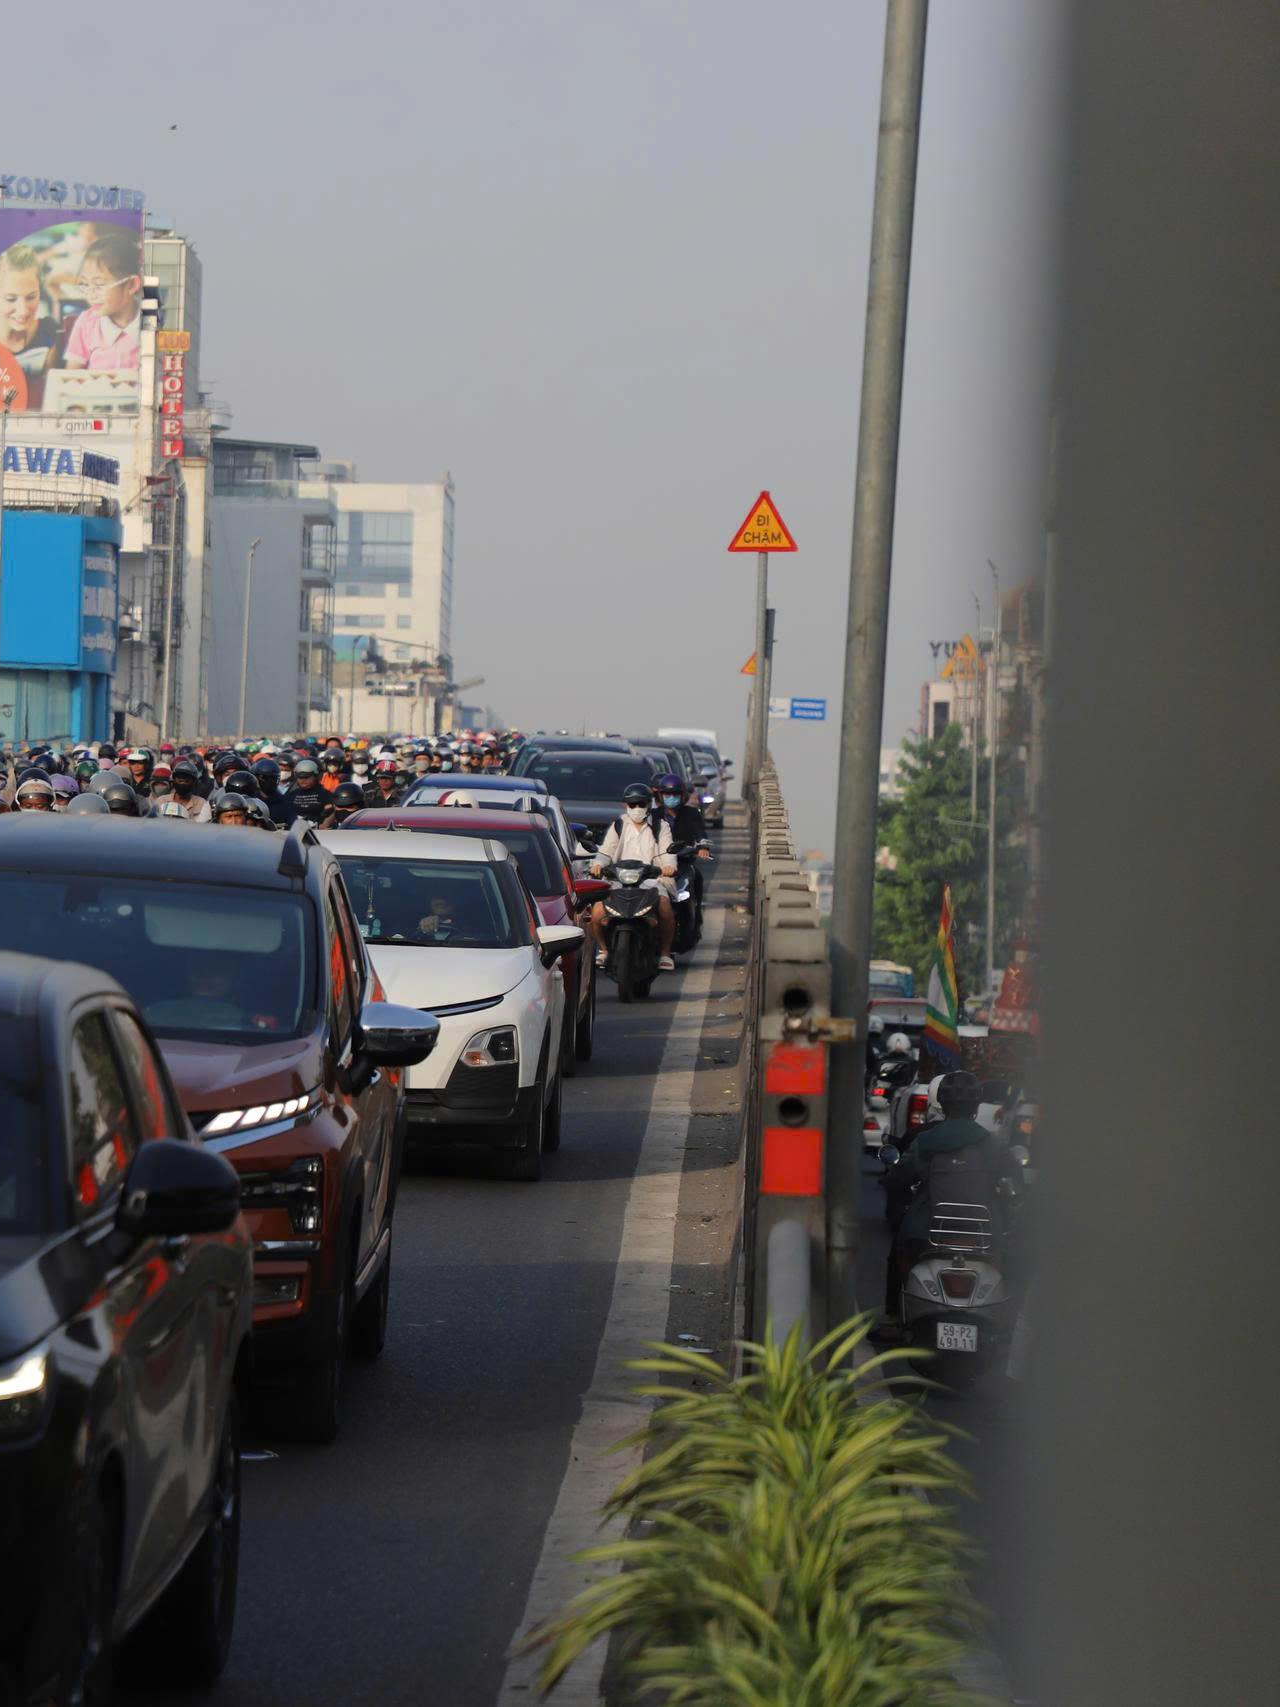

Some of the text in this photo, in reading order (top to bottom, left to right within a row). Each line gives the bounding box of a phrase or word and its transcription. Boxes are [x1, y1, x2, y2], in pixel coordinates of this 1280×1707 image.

[73, 182, 146, 210] TOWER
[163, 355, 183, 456] HOTEL
[756, 514, 770, 527] ĐI
